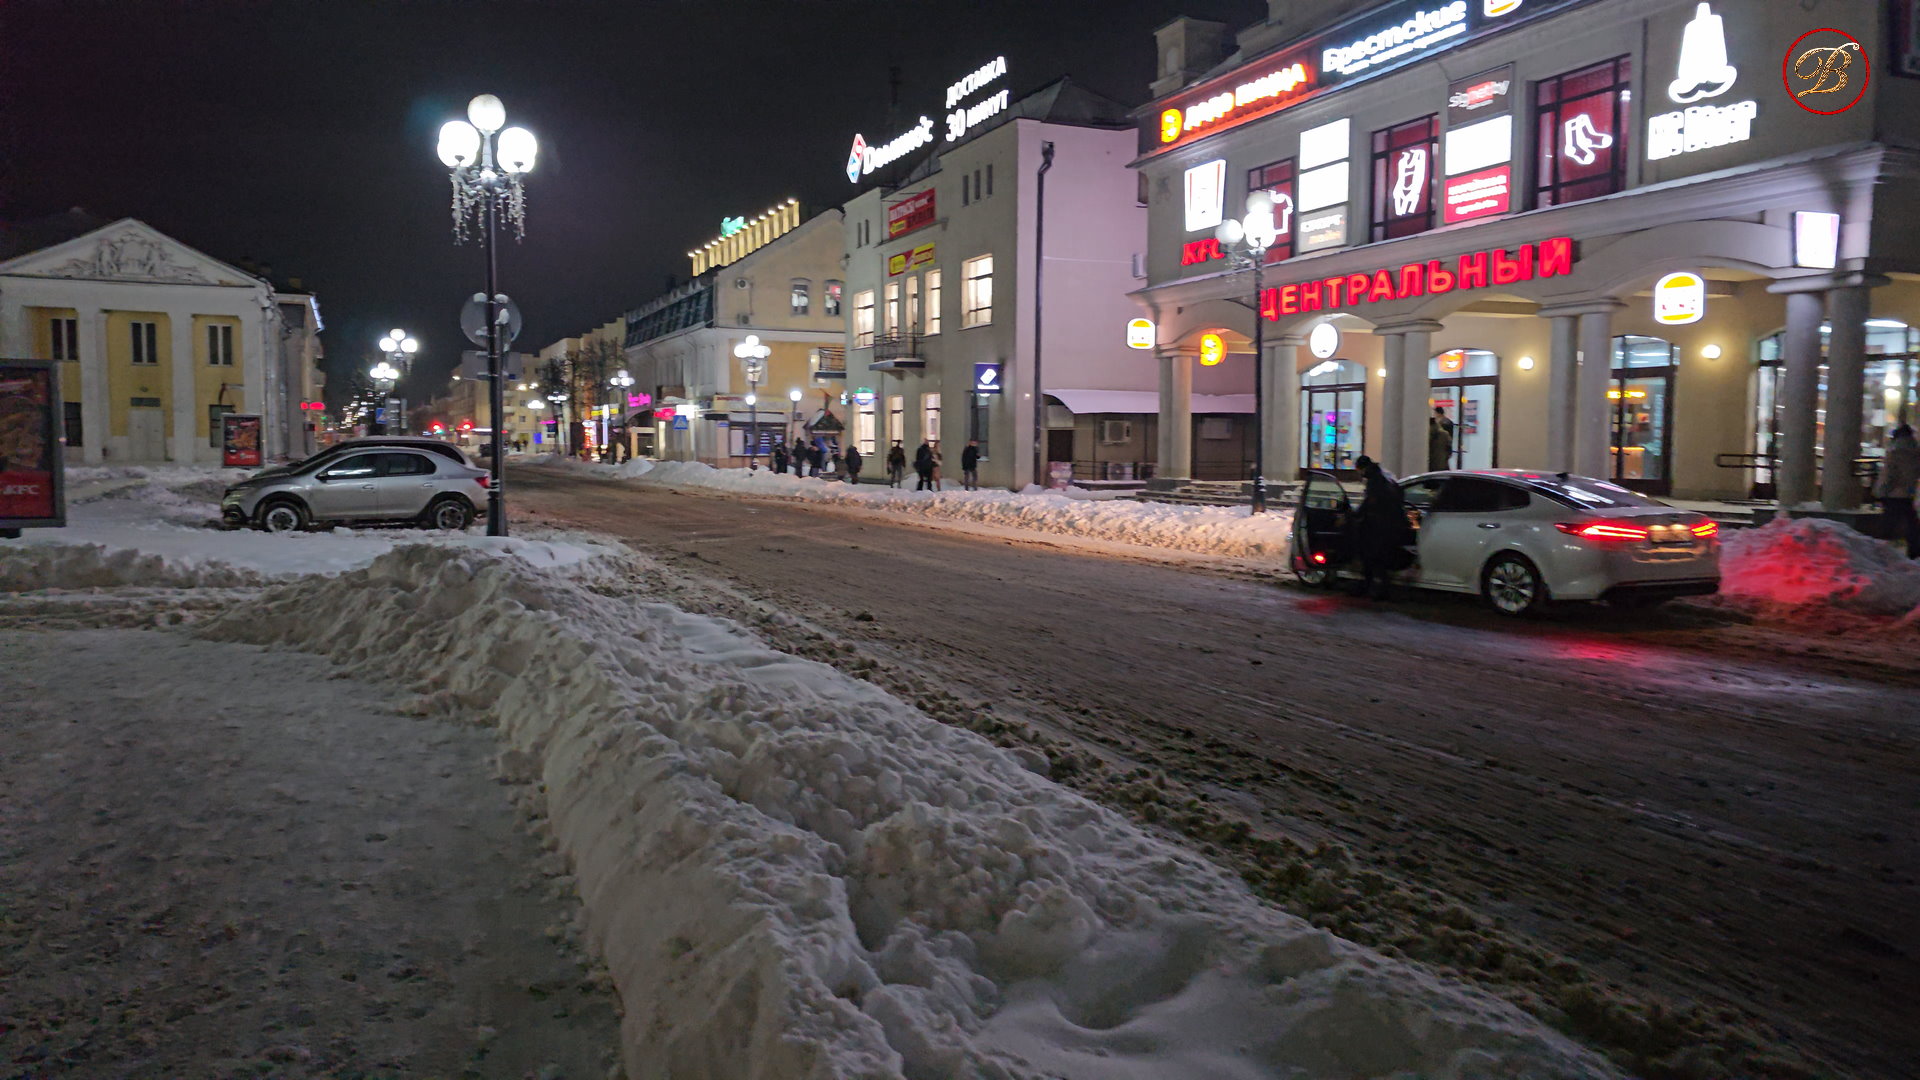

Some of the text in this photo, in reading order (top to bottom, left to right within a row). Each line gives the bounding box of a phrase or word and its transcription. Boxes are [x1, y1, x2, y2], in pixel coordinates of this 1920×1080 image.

[1323, 0, 1467, 73] Брестские
[946, 56, 1008, 109] ДОСТАВКА
[945, 108, 967, 142] 30
[1181, 238, 1226, 267] KFC
[1259, 236, 1572, 322] ЦЕНТРАЛЬНЫЙ
